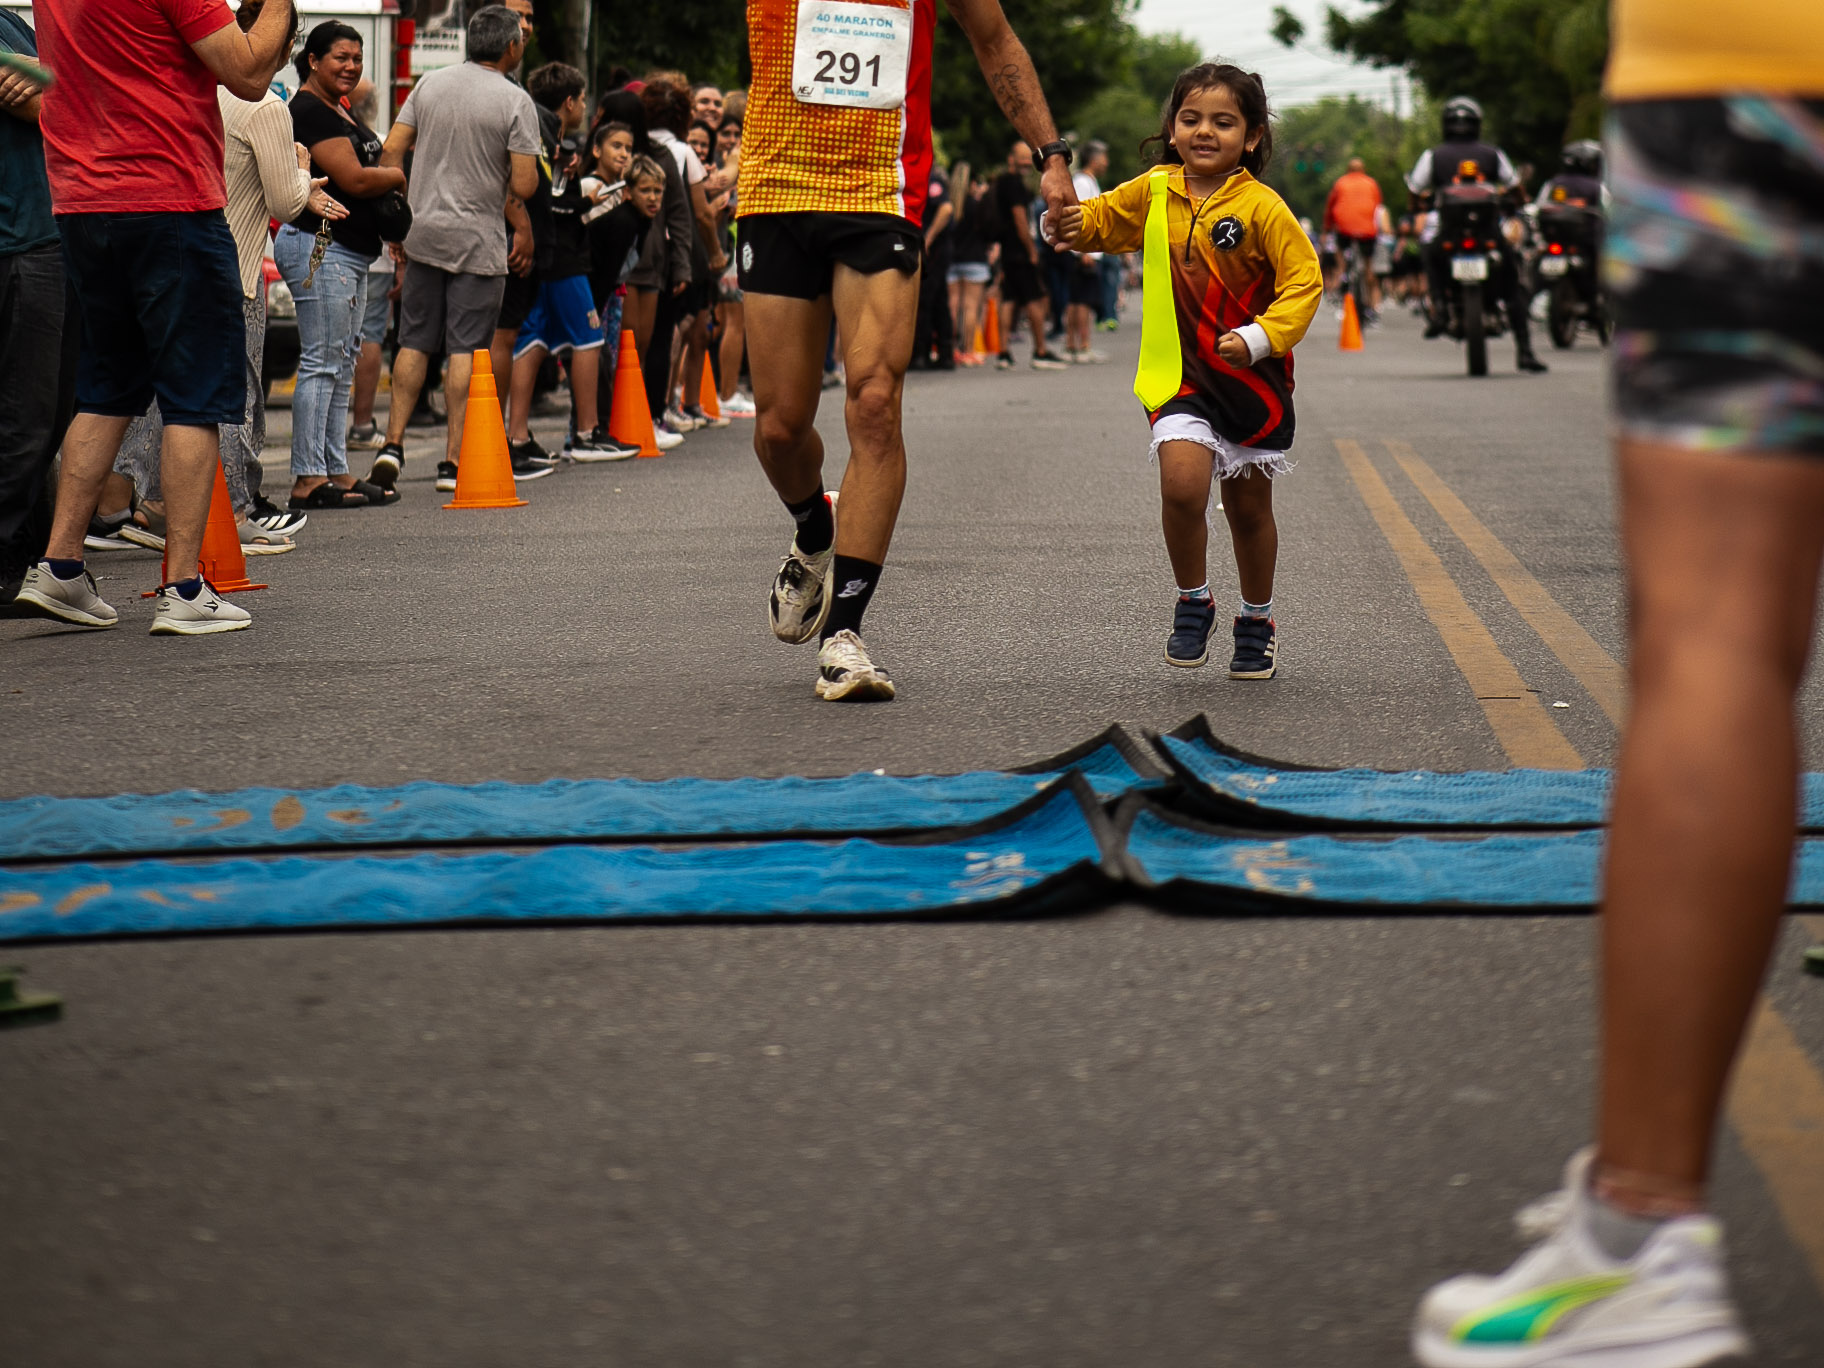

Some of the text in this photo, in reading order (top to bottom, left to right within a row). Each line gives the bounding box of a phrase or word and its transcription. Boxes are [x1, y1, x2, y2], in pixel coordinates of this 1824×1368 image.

[817, 13, 893, 28] 40 MARATON
[811, 26, 896, 40] EMPALME GRANEROS
[814, 50, 881, 88] 291
